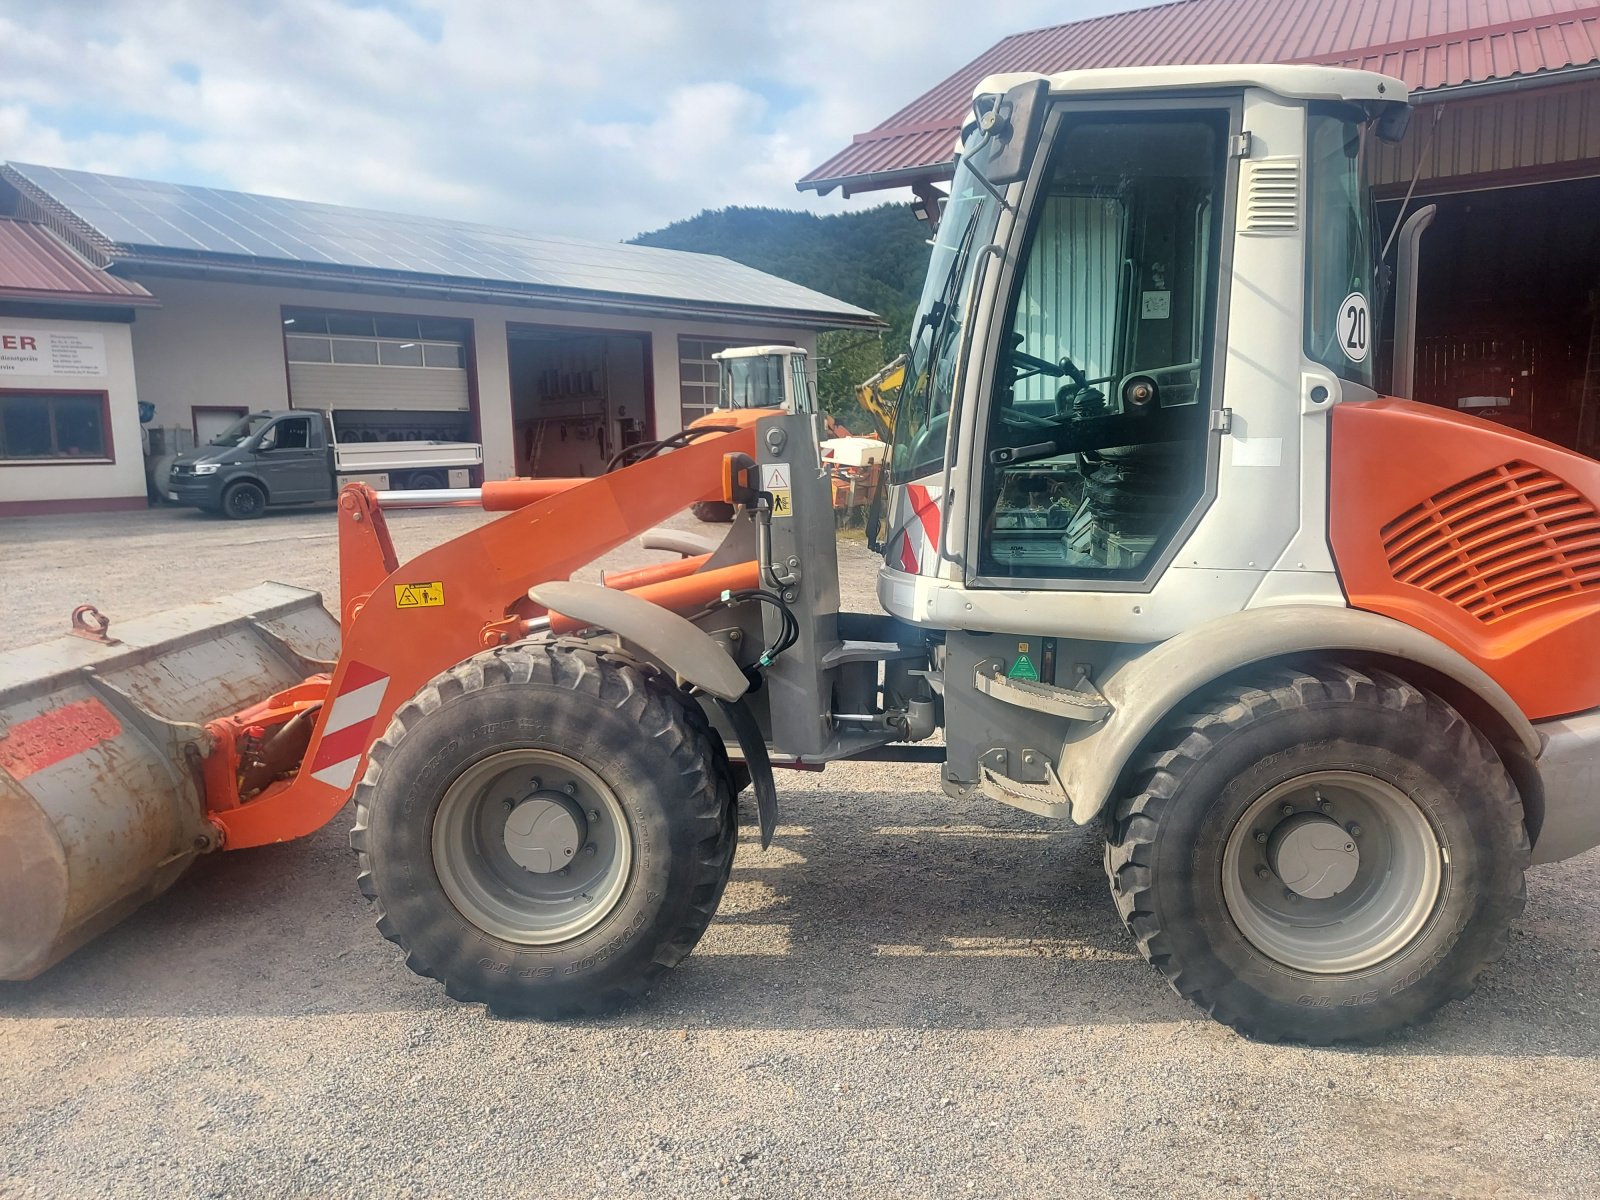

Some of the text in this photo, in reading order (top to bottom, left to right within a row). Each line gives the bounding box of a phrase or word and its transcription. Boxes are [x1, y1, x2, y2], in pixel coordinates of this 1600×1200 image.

[1347, 305, 1366, 349] 20
[2, 335, 37, 351] ER
[564, 909, 648, 976] DUNLOP
[519, 966, 553, 979] SP
[1341, 989, 1379, 1008] SP
